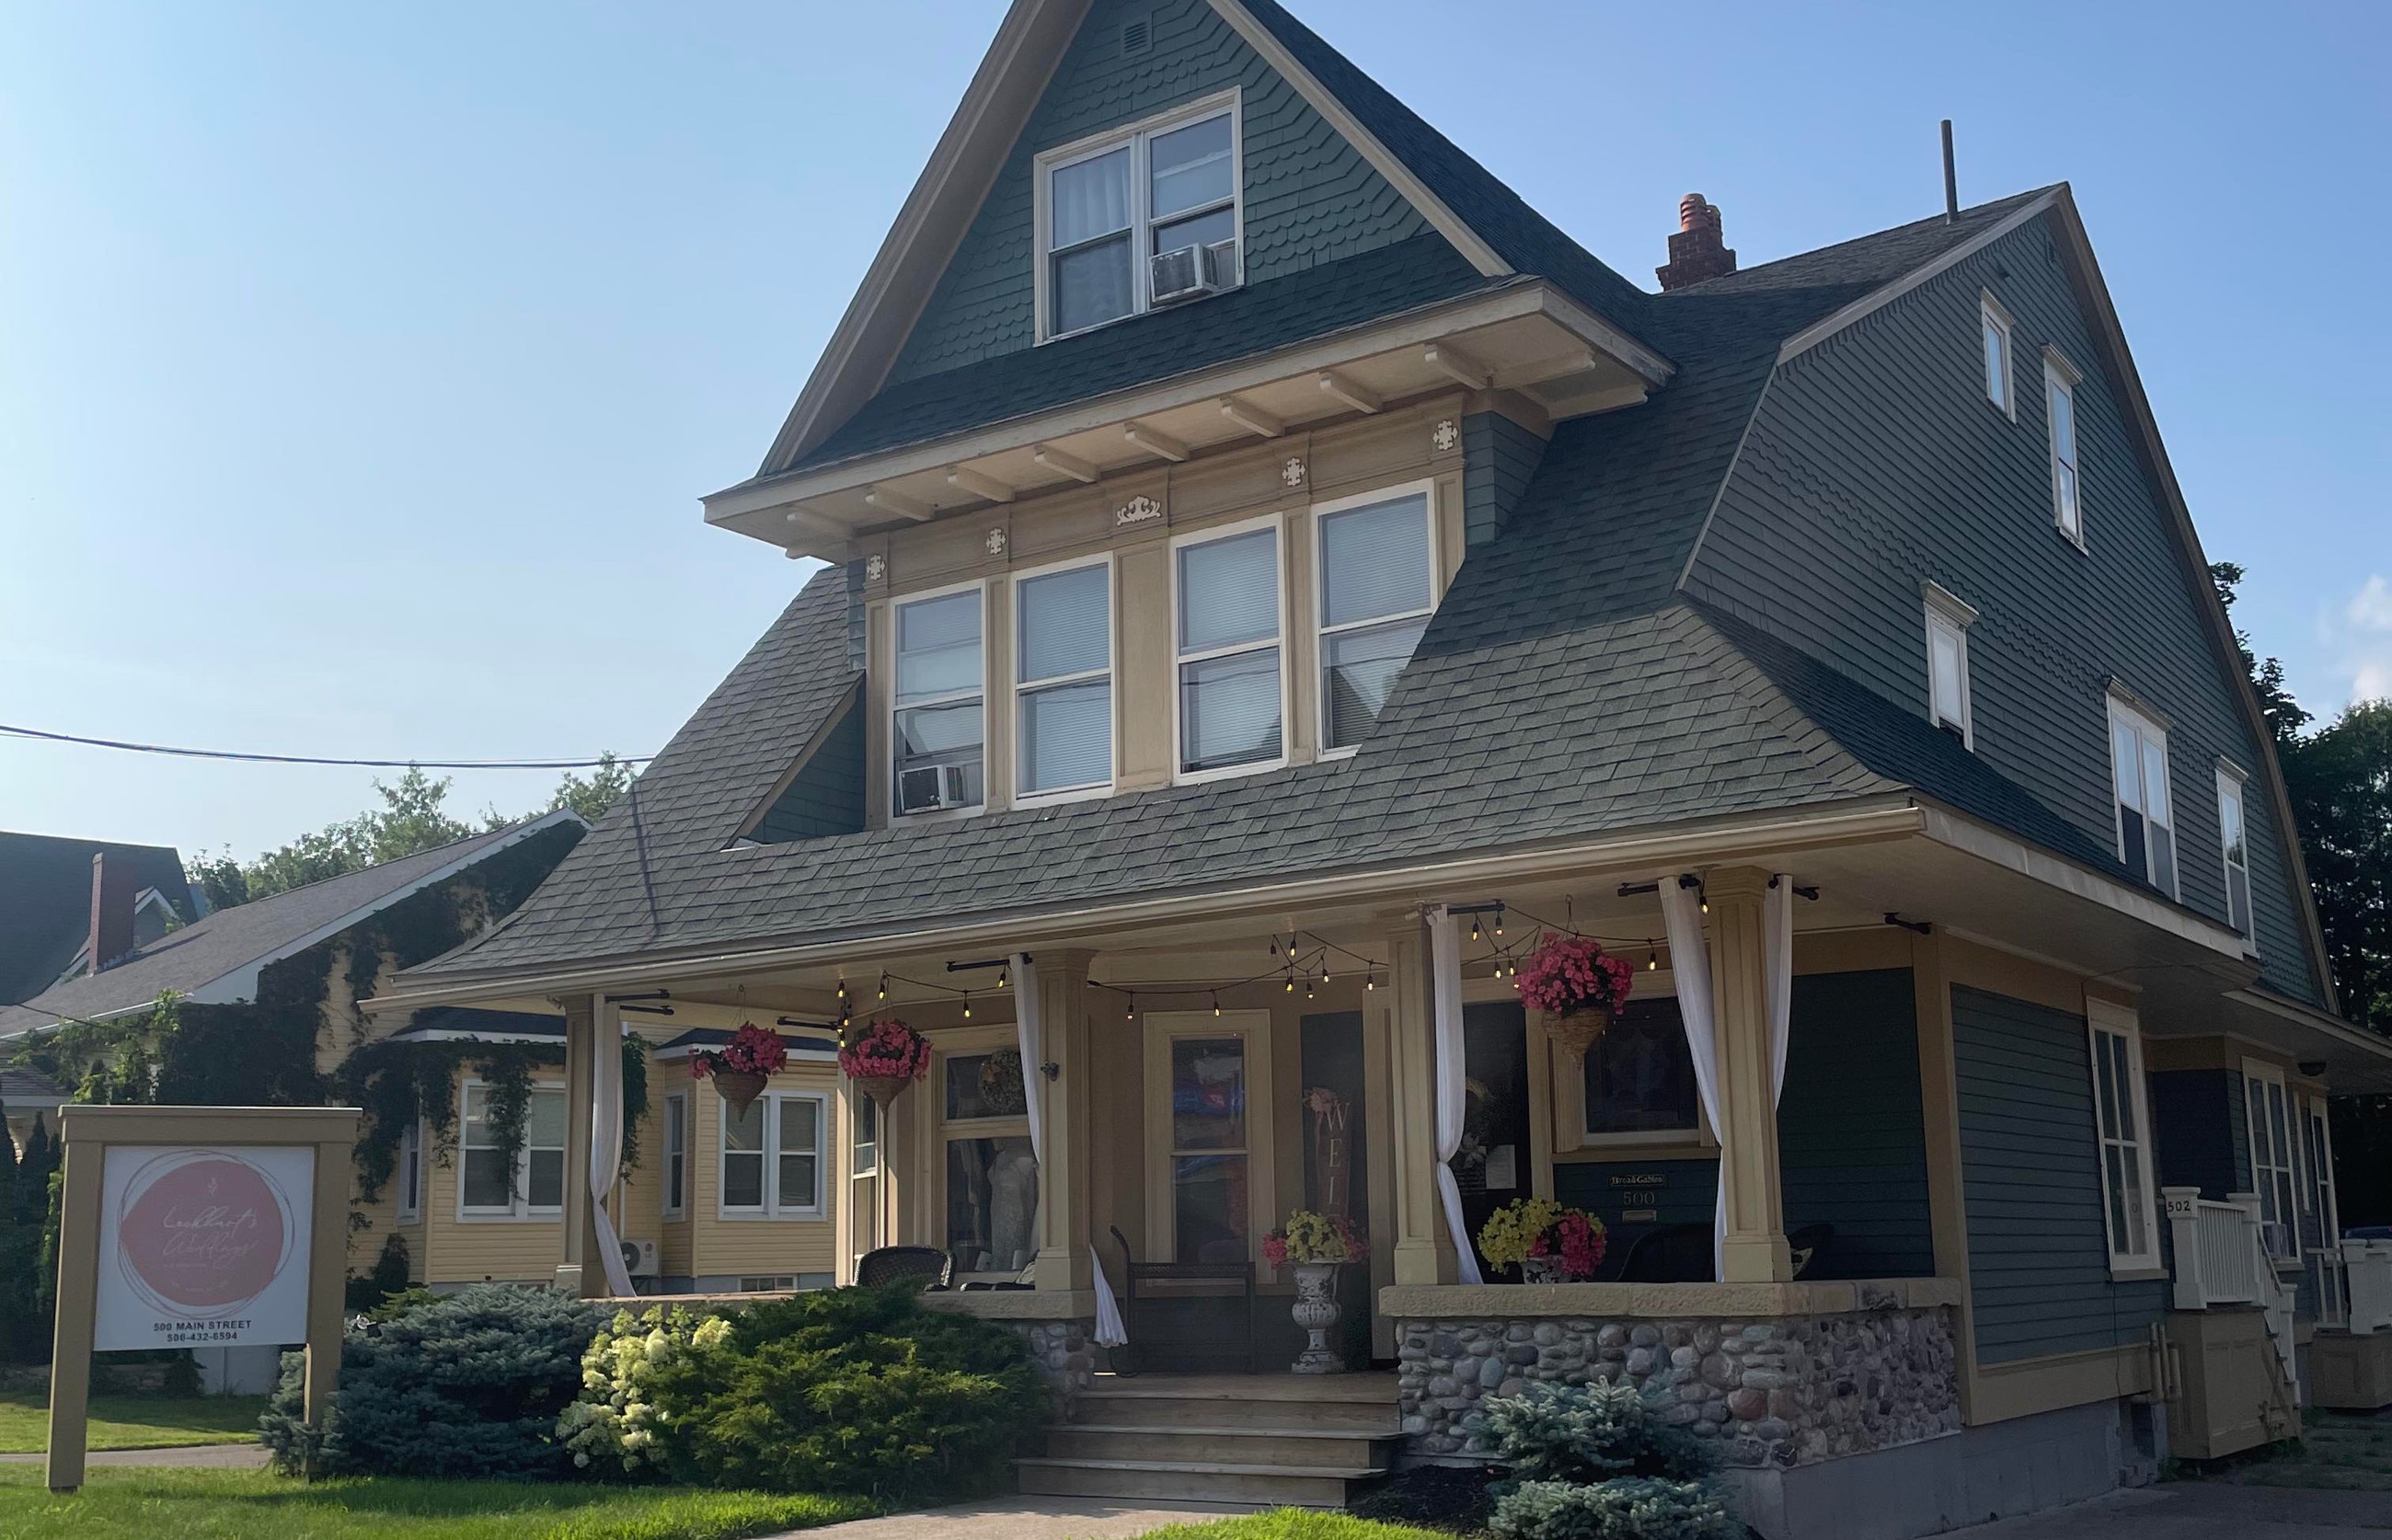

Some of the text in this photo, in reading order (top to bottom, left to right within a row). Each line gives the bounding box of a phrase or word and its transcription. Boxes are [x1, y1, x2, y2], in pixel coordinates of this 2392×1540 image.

[1327, 1102, 1351, 1217] WEL
[1623, 1191, 1655, 1205] 500
[2167, 1201, 2191, 1212] 502
[153, 1319, 252, 1331] 500 MAIN STREET
[167, 1331, 238, 1341] 506-432-6594
